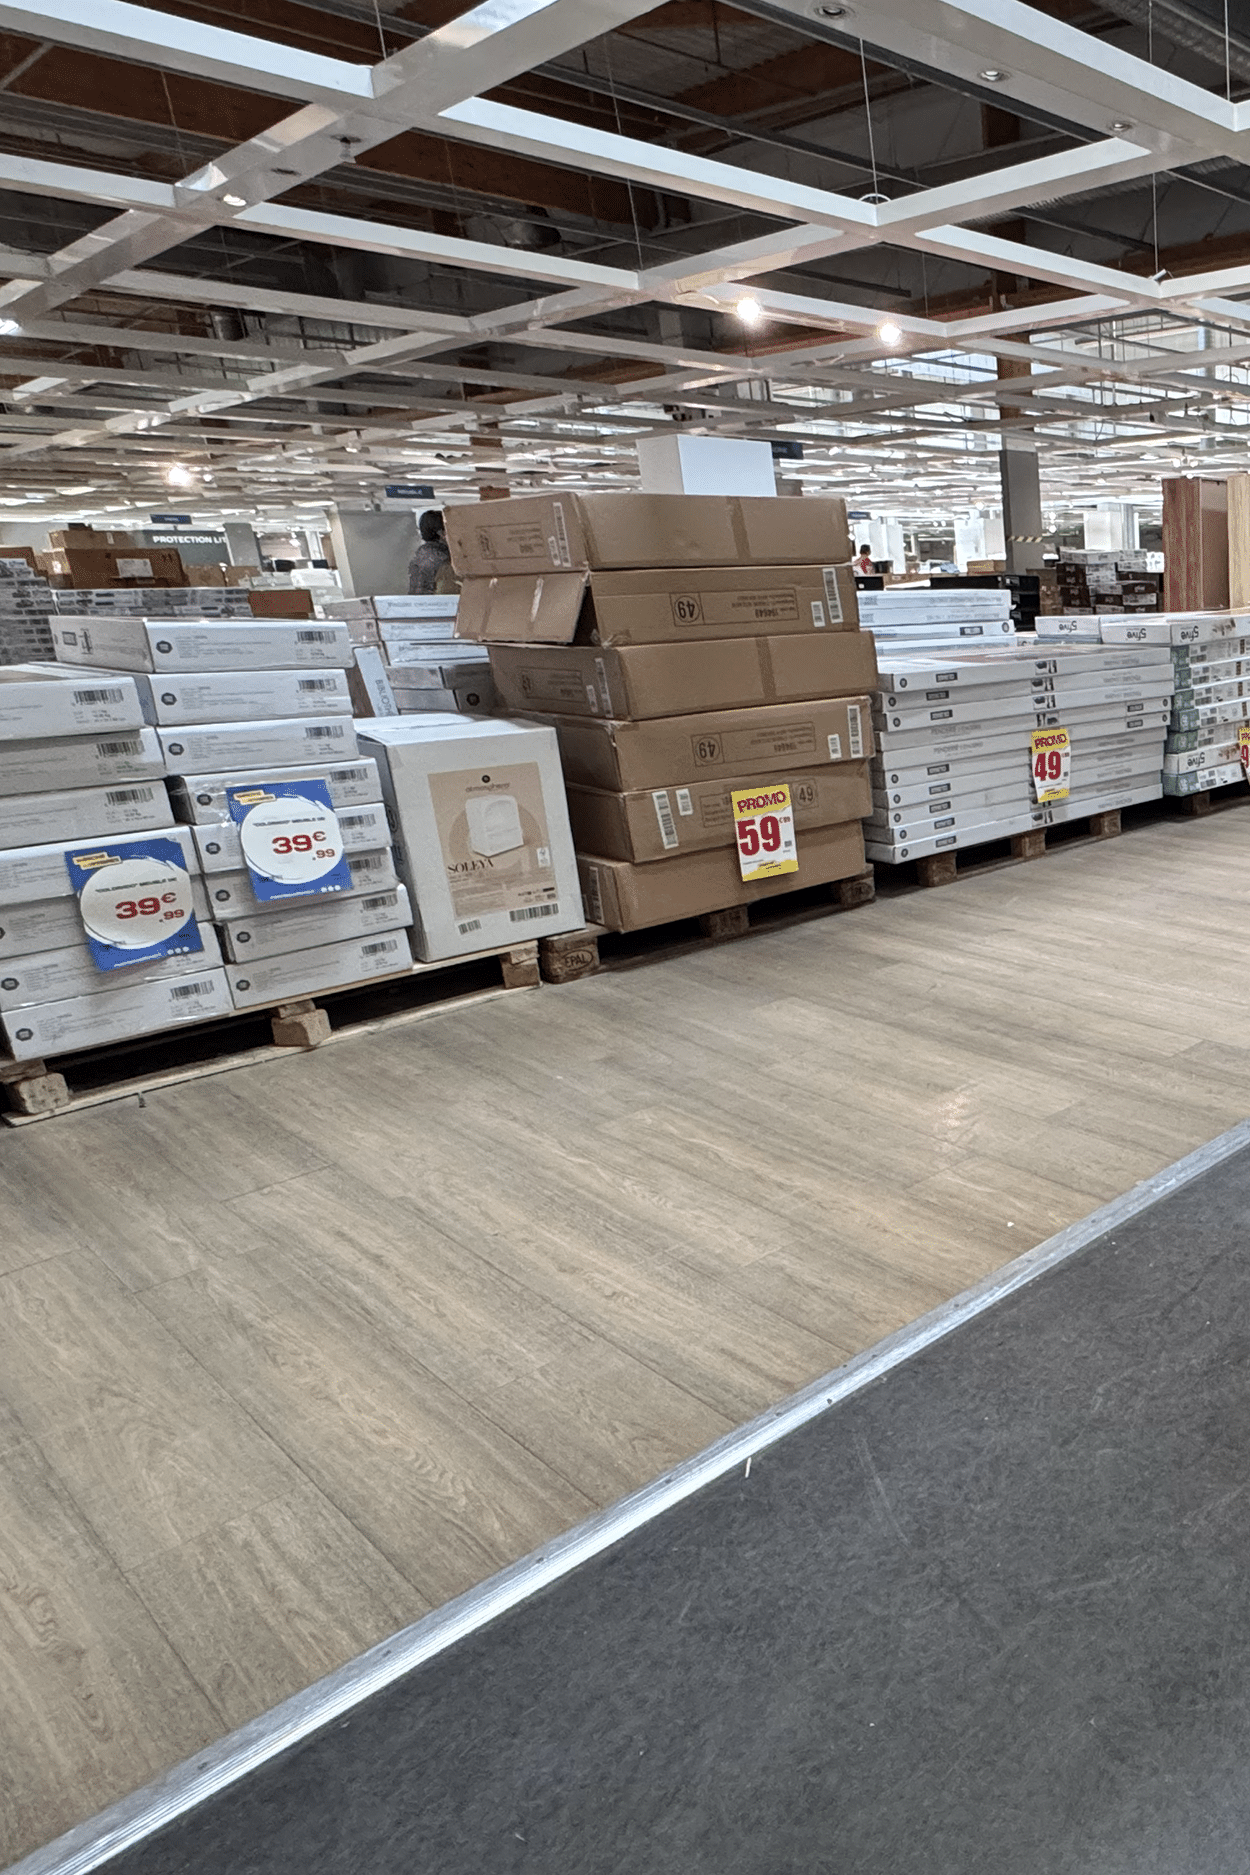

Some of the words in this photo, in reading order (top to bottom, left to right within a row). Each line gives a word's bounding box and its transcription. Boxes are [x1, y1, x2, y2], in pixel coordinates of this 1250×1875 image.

[152, 535, 212, 543] PROTECTION
[677, 600, 696, 619] 49
[699, 740, 716, 759] 49
[1034, 733, 1067, 749] PROMO
[1034, 750, 1061, 781] 49
[736, 790, 786, 814] PROMO
[799, 786, 814, 802] 49
[737, 815, 781, 856] 59
[447, 858, 494, 873] SOLEYA
